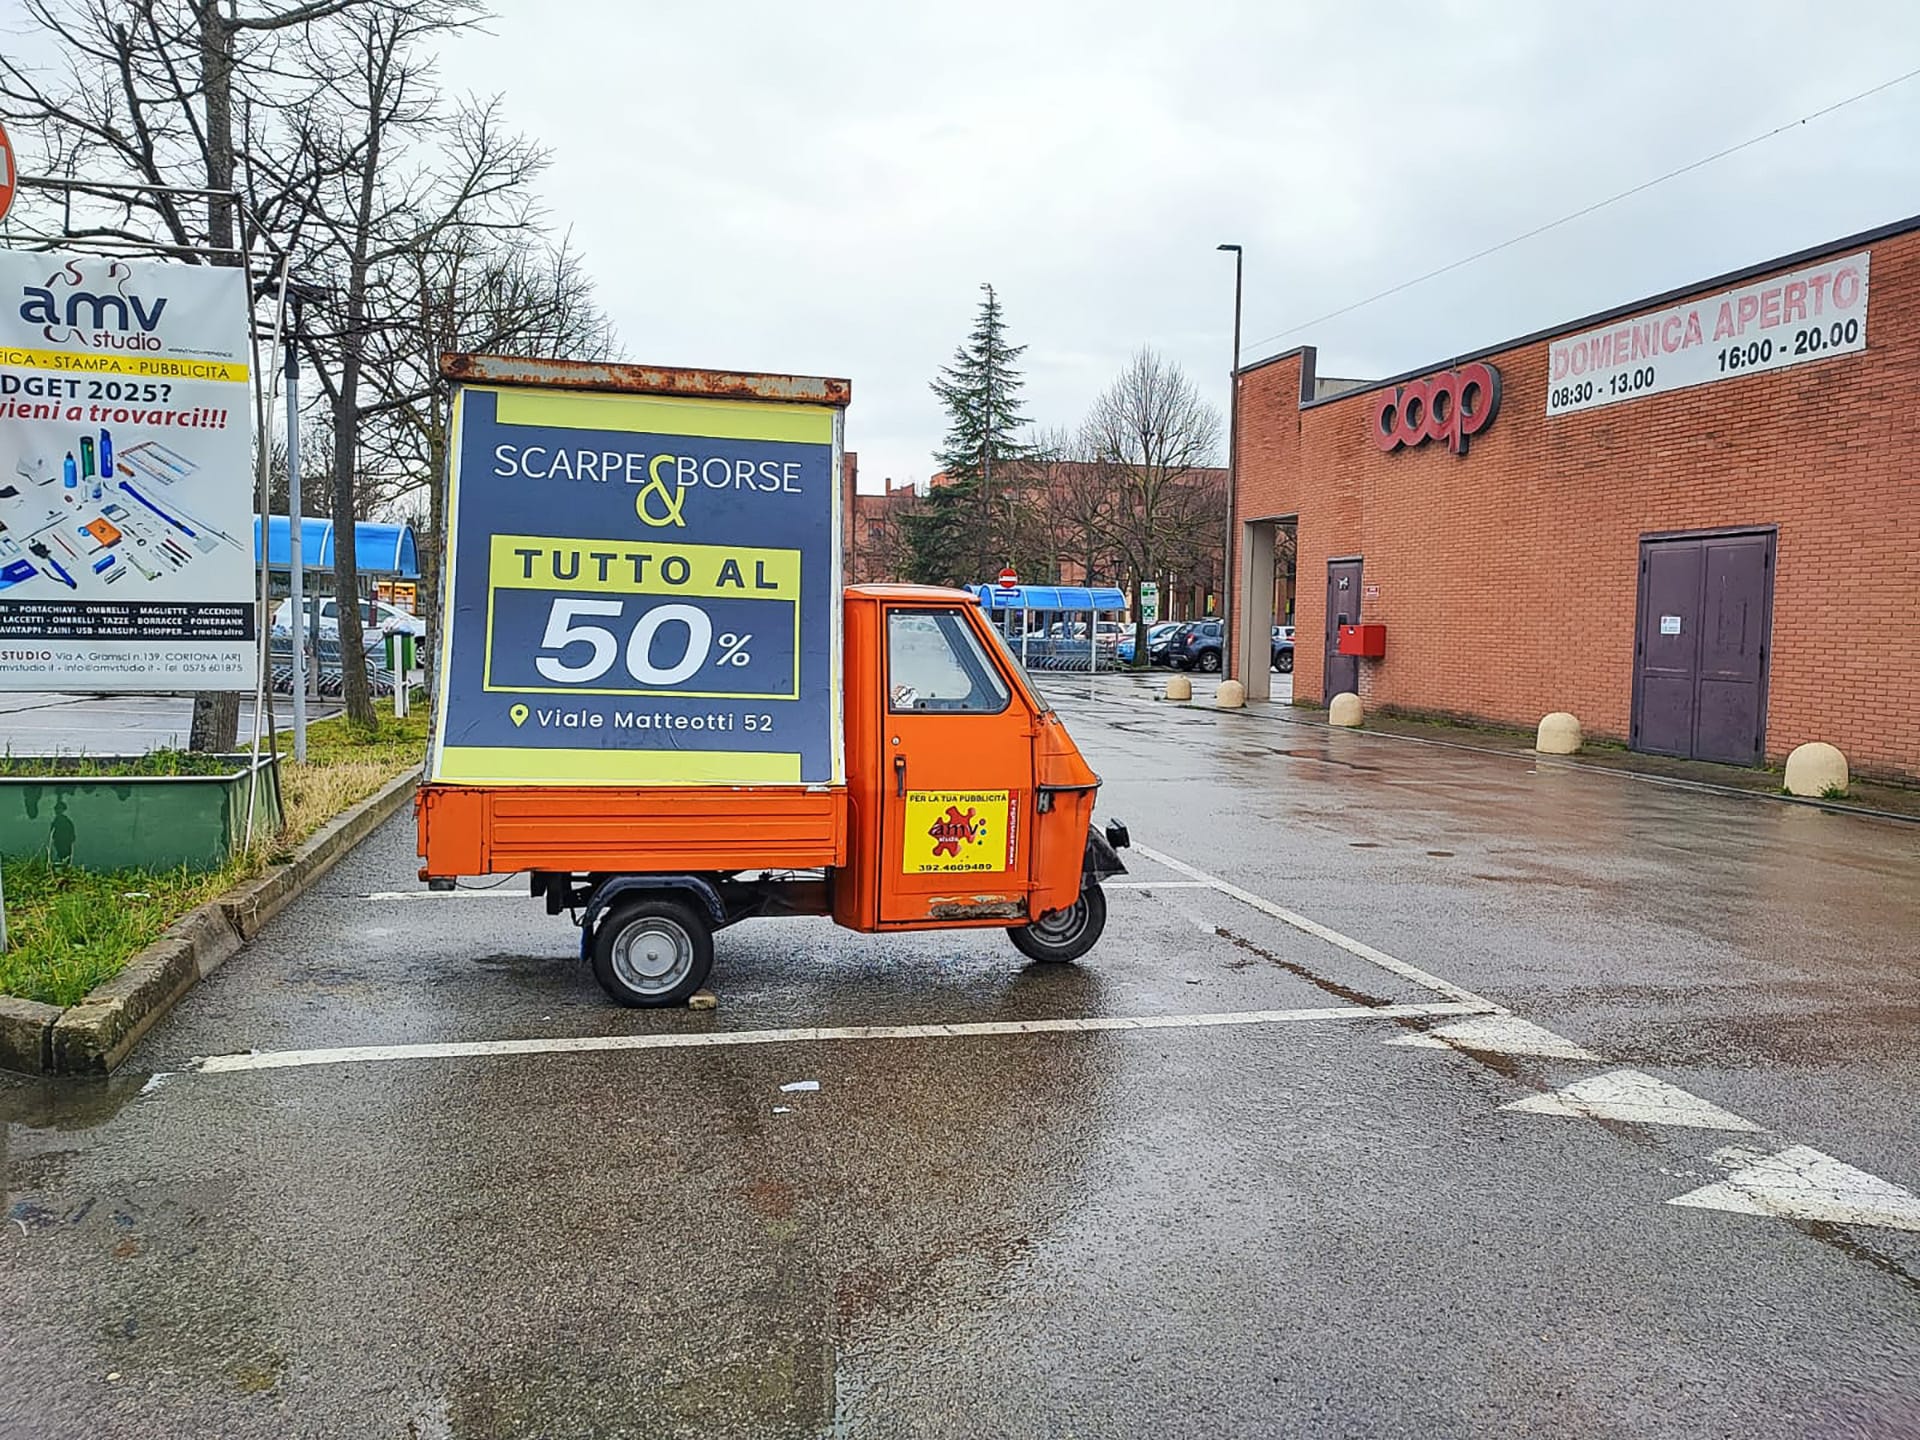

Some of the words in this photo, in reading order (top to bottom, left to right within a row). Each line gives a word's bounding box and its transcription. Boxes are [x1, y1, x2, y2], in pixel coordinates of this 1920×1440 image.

[20, 286, 168, 331] amv
[1553, 310, 1703, 381] DOMENICA
[1713, 266, 1860, 341] APERTO
[93, 332, 162, 351] studio
[1718, 339, 1772, 372] 16:00
[1794, 318, 1858, 355] 20.00
[54, 355, 121, 372] STAMPA
[140, 361, 230, 379] PUBBLICITÀ
[1, 374, 81, 398] DGET
[88, 380, 172, 402] 2025?
[1552, 381, 1593, 408] 08:30
[1610, 366, 1654, 395] 13.00
[66, 406, 81, 421] a
[90, 403, 227, 428] trovarci!!!
[1374, 362, 1498, 455] coop
[494, 444, 645, 484] SCARPE
[635, 454, 686, 527] &
[676, 456, 802, 493] BORSE
[514, 549, 691, 585] TUTTO
[716, 558, 778, 589] AL
[1, 651, 51, 660] STUDIO
[55, 652, 72, 661] Via
[88, 652, 130, 661] Gramsci
[164, 653, 217, 662] CORTONA
[537, 708, 604, 728] Viale
[614, 710, 733, 731] Matteotti
[744, 714, 773, 732] 52
[930, 823, 978, 836] amv
